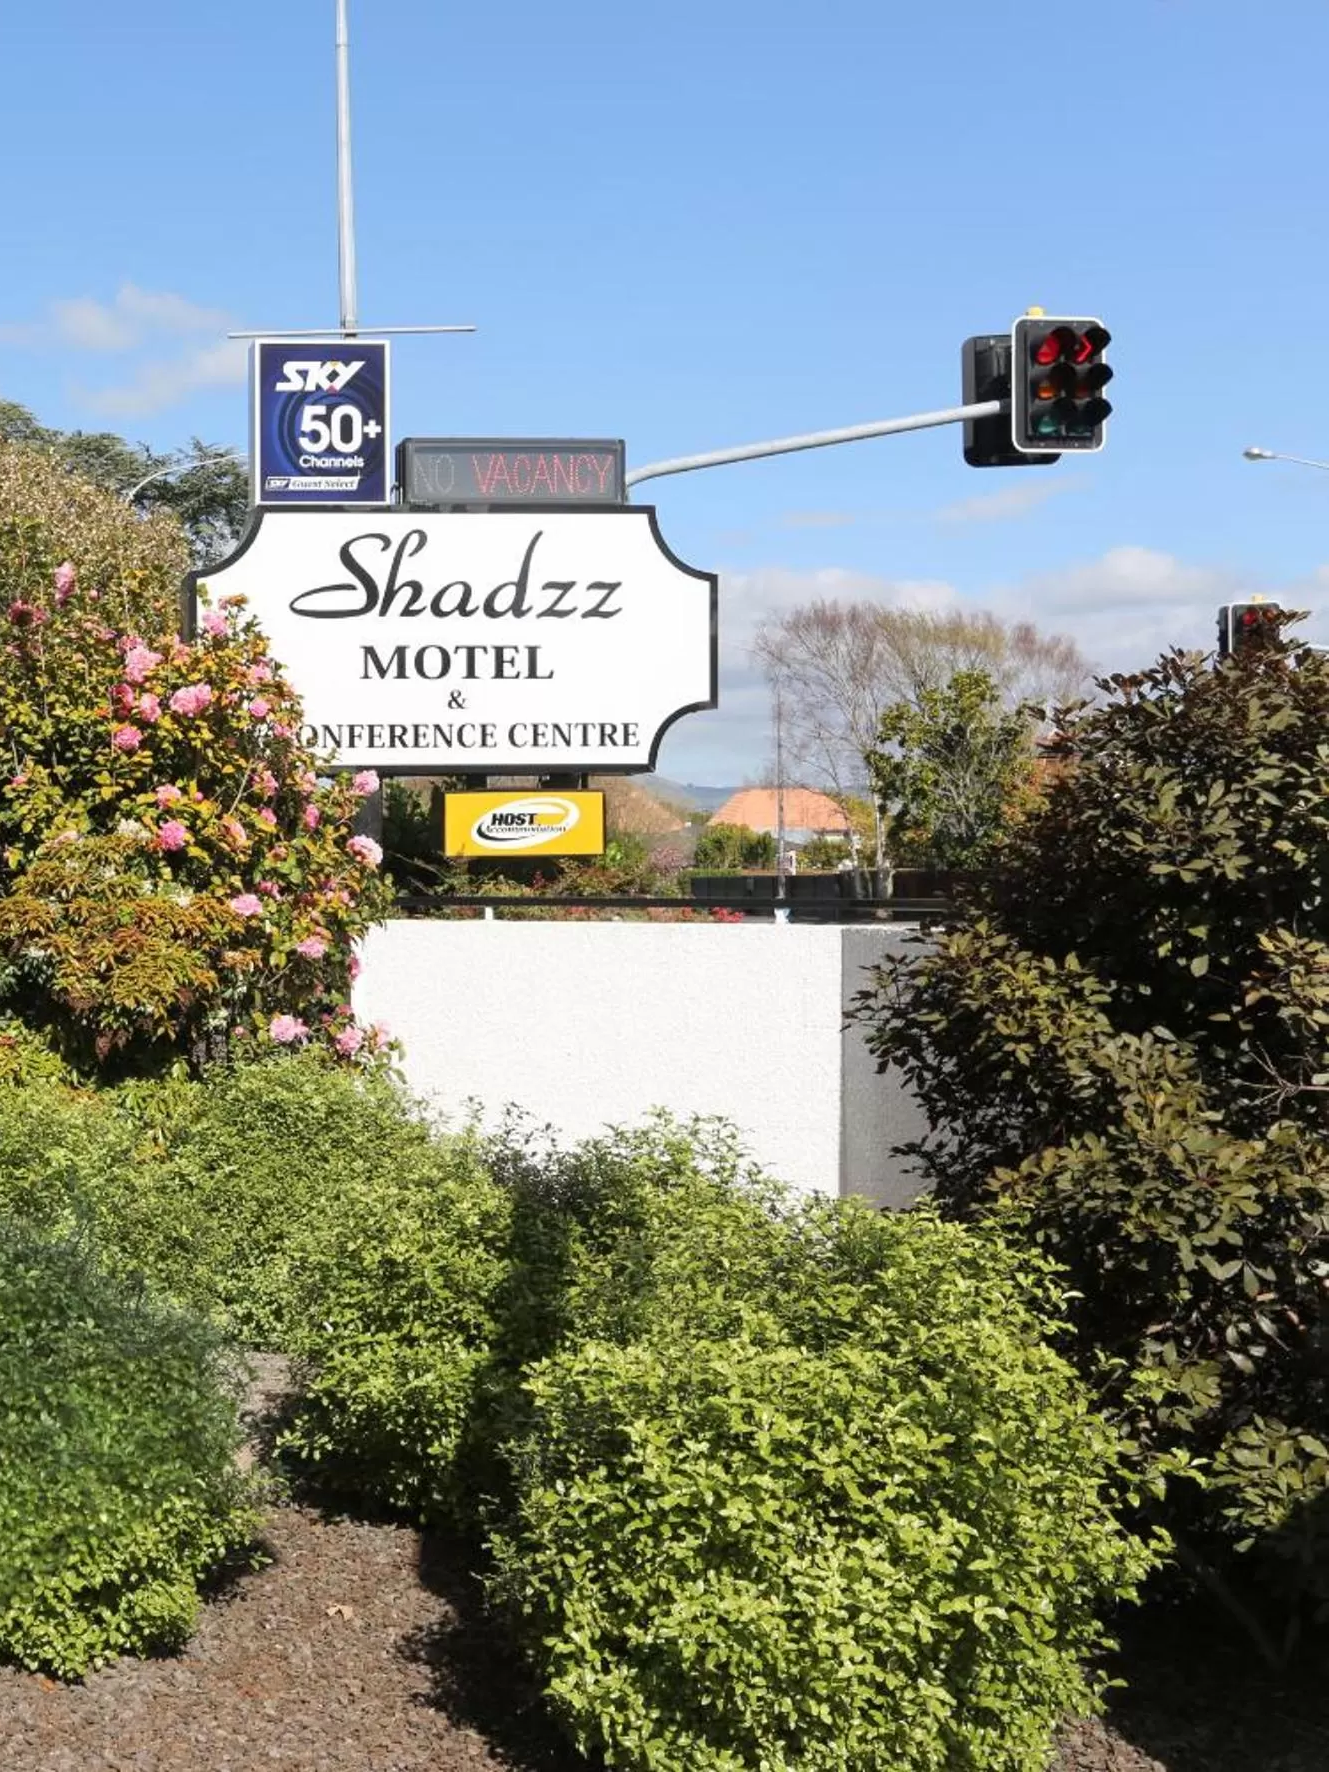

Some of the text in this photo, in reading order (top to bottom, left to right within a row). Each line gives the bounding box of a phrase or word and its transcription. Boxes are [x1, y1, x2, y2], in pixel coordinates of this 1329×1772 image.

[275, 360, 365, 392] SKY
[299, 405, 382, 453] 50+
[299, 455, 364, 468] Channels
[414, 453, 614, 496] NO VACANCY
[289, 528, 623, 619] Shadzz
[360, 645, 554, 680] MOTEL
[447, 689, 468, 709] &
[296, 722, 640, 749] ONFERENCE CENTRE
[491, 812, 538, 826] HOST
